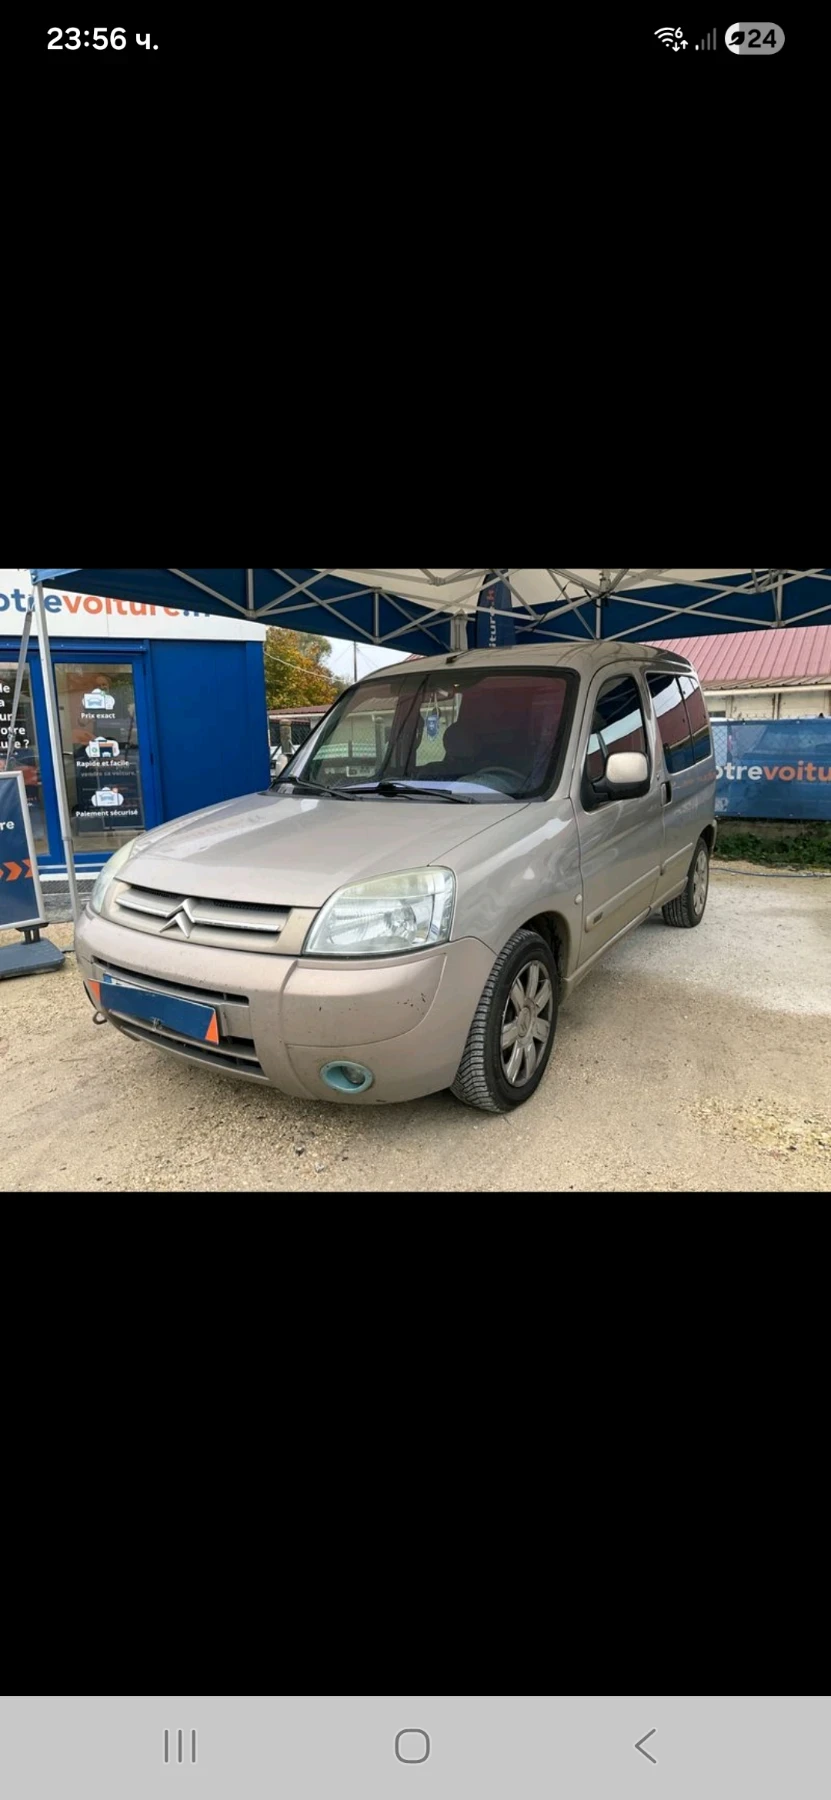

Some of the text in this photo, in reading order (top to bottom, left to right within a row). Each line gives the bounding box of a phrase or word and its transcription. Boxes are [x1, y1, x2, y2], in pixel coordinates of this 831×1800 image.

[0, 727, 26, 735] ore
[1, 740, 21, 749] ue
[76, 760, 100, 768] Rapide
[75, 810, 109, 818] Paiement
